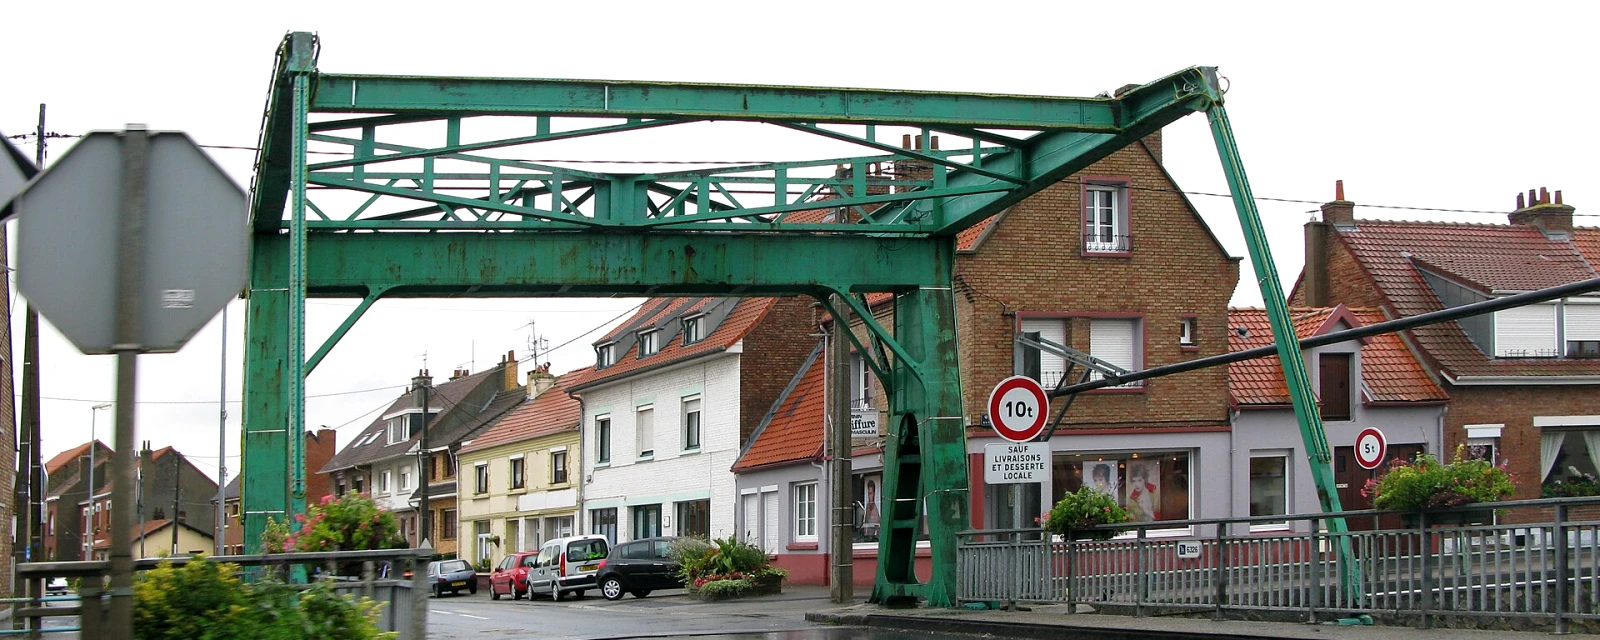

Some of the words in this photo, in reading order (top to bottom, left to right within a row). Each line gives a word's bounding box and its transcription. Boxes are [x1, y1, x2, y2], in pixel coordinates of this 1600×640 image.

[1005, 401, 1033, 418] 10t
[1008, 445, 1029, 453] SAUF
[994, 454, 1041, 463] LIVRAISONS
[992, 464, 1002, 472] ET
[1005, 463, 1044, 471] DESSERTE
[1003, 472, 1033, 480] LOCALE
